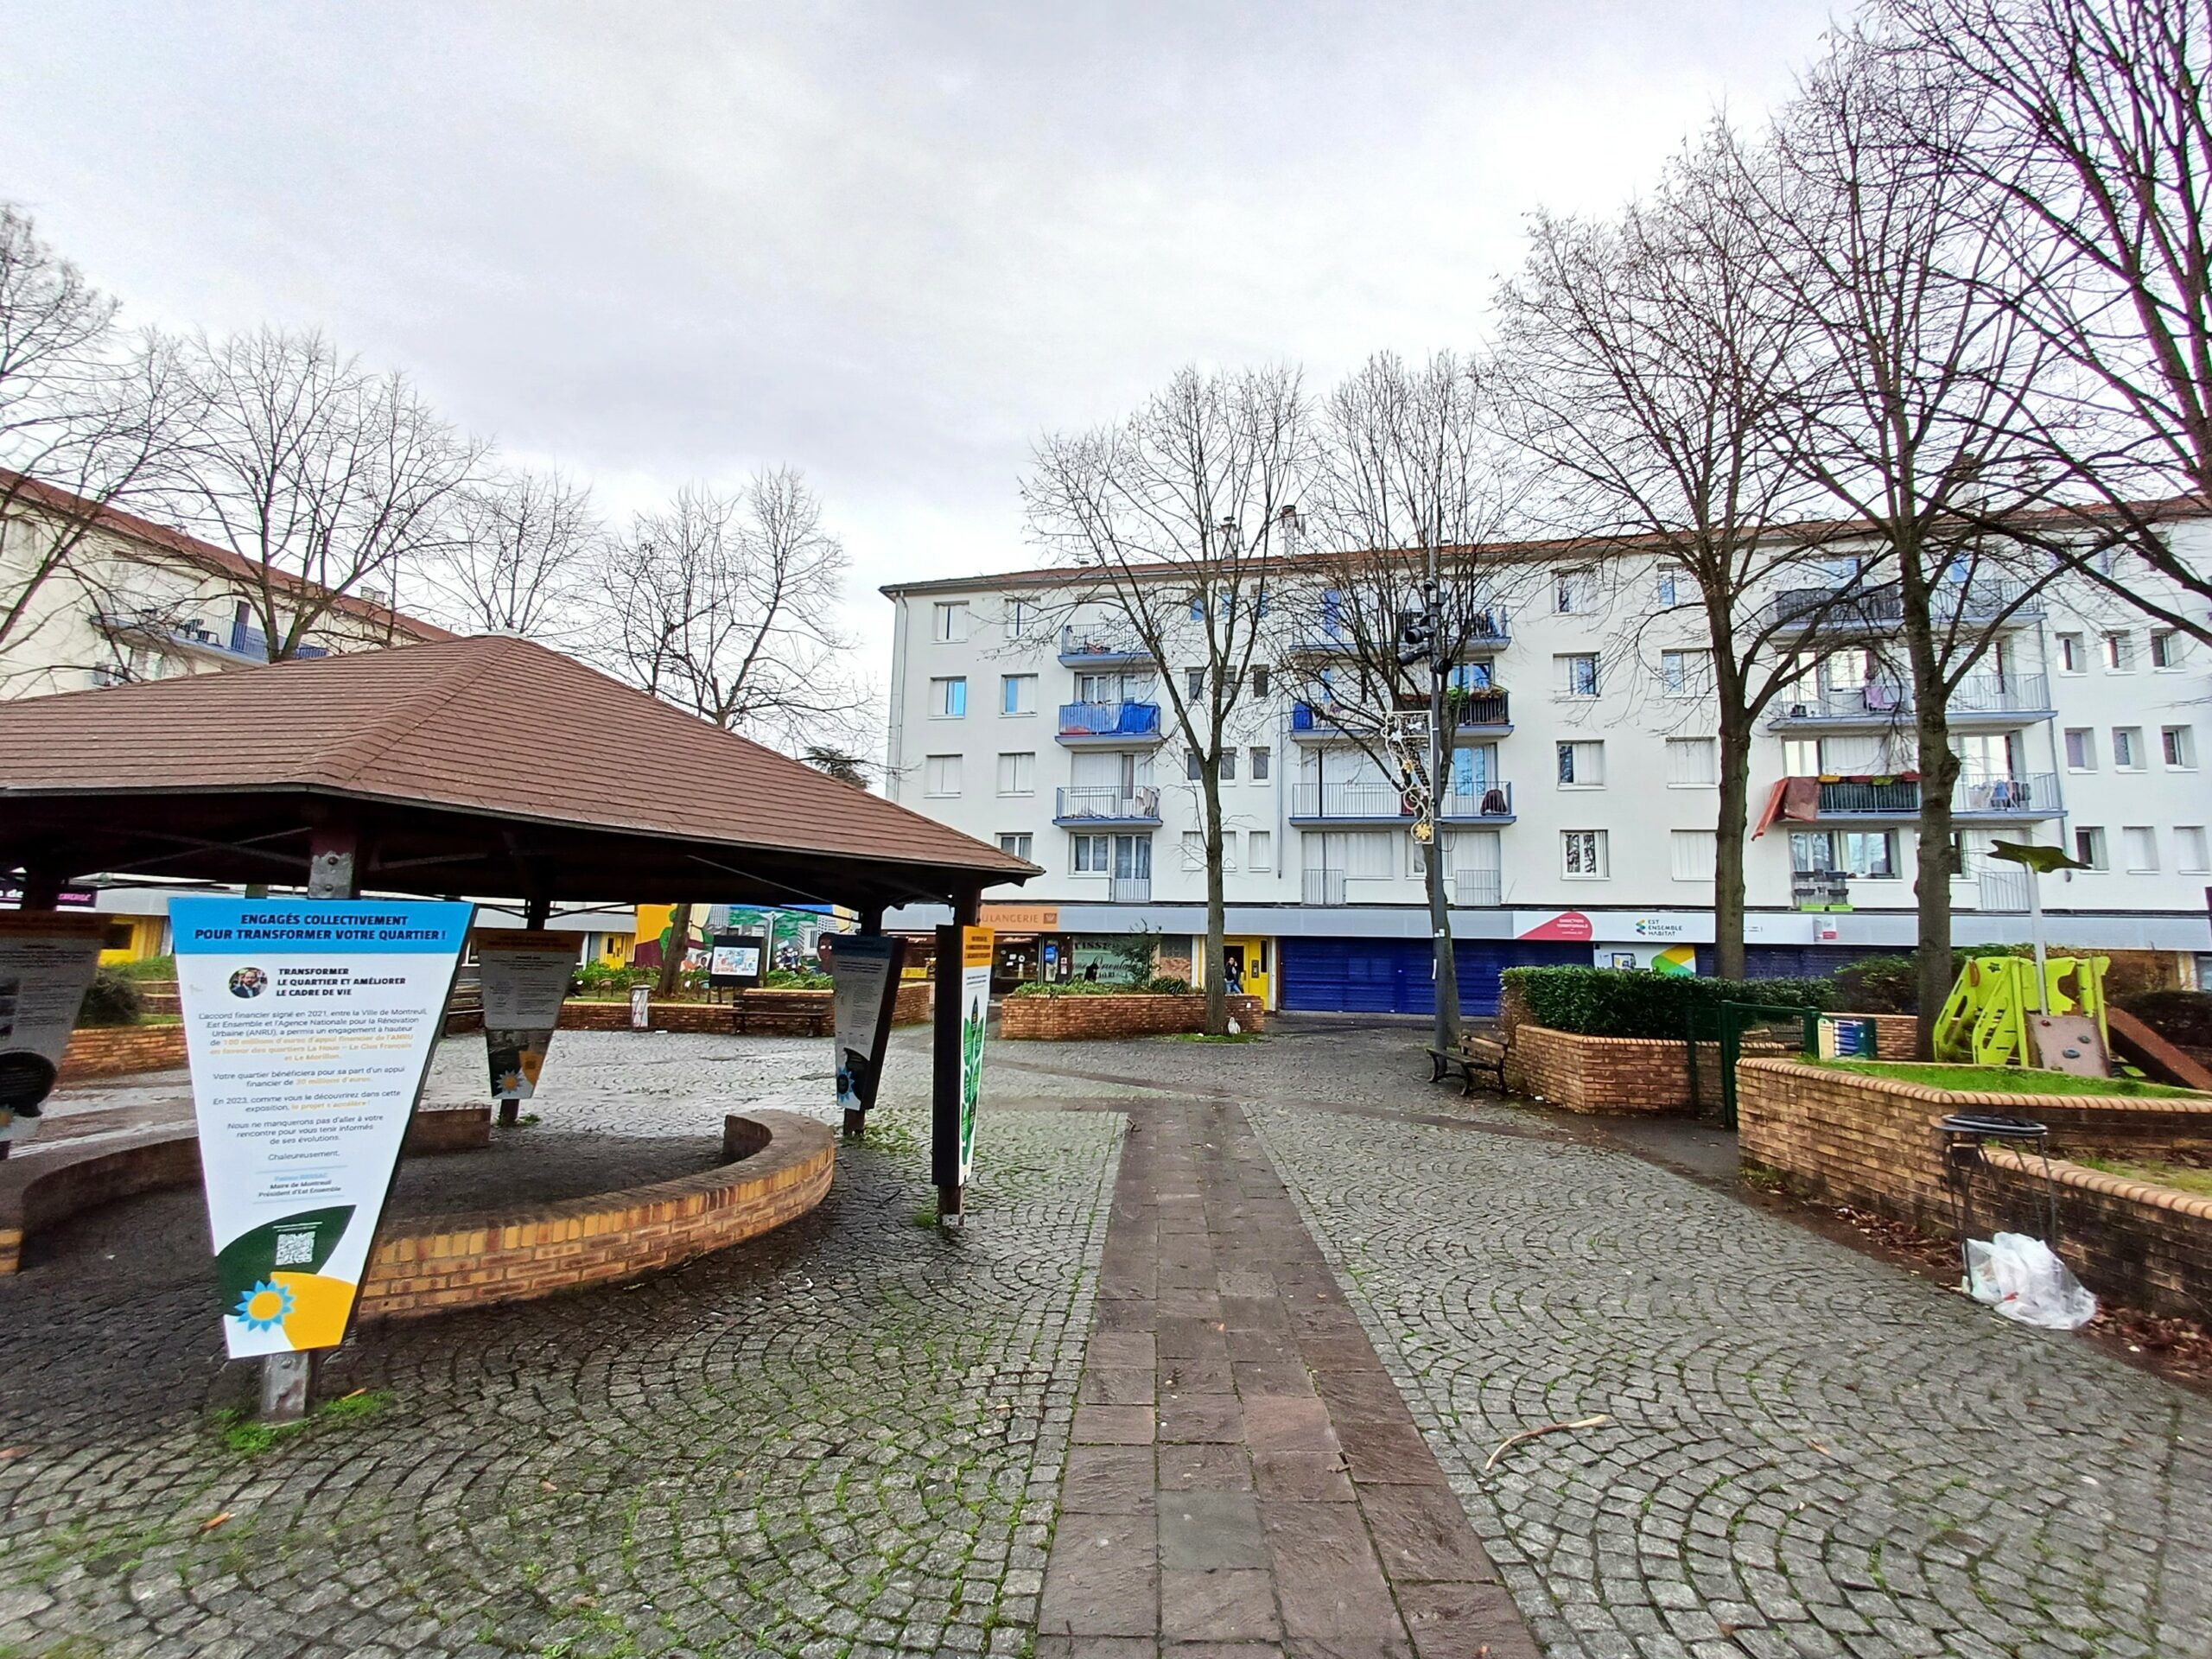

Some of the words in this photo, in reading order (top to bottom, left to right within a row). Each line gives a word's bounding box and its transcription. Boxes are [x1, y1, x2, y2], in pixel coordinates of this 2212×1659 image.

[241, 912, 300, 925] ENGAGÉS
[304, 915, 409, 925] COLLECTIVEMENT
[981, 914, 1039, 923] ULANGERIE
[195, 930, 232, 939] POUR
[236, 930, 332, 939] TRANSFORMER
[335, 930, 375, 940] VOTRE
[378, 930, 439, 941] QUARTIER
[442, 931, 446, 940] !
